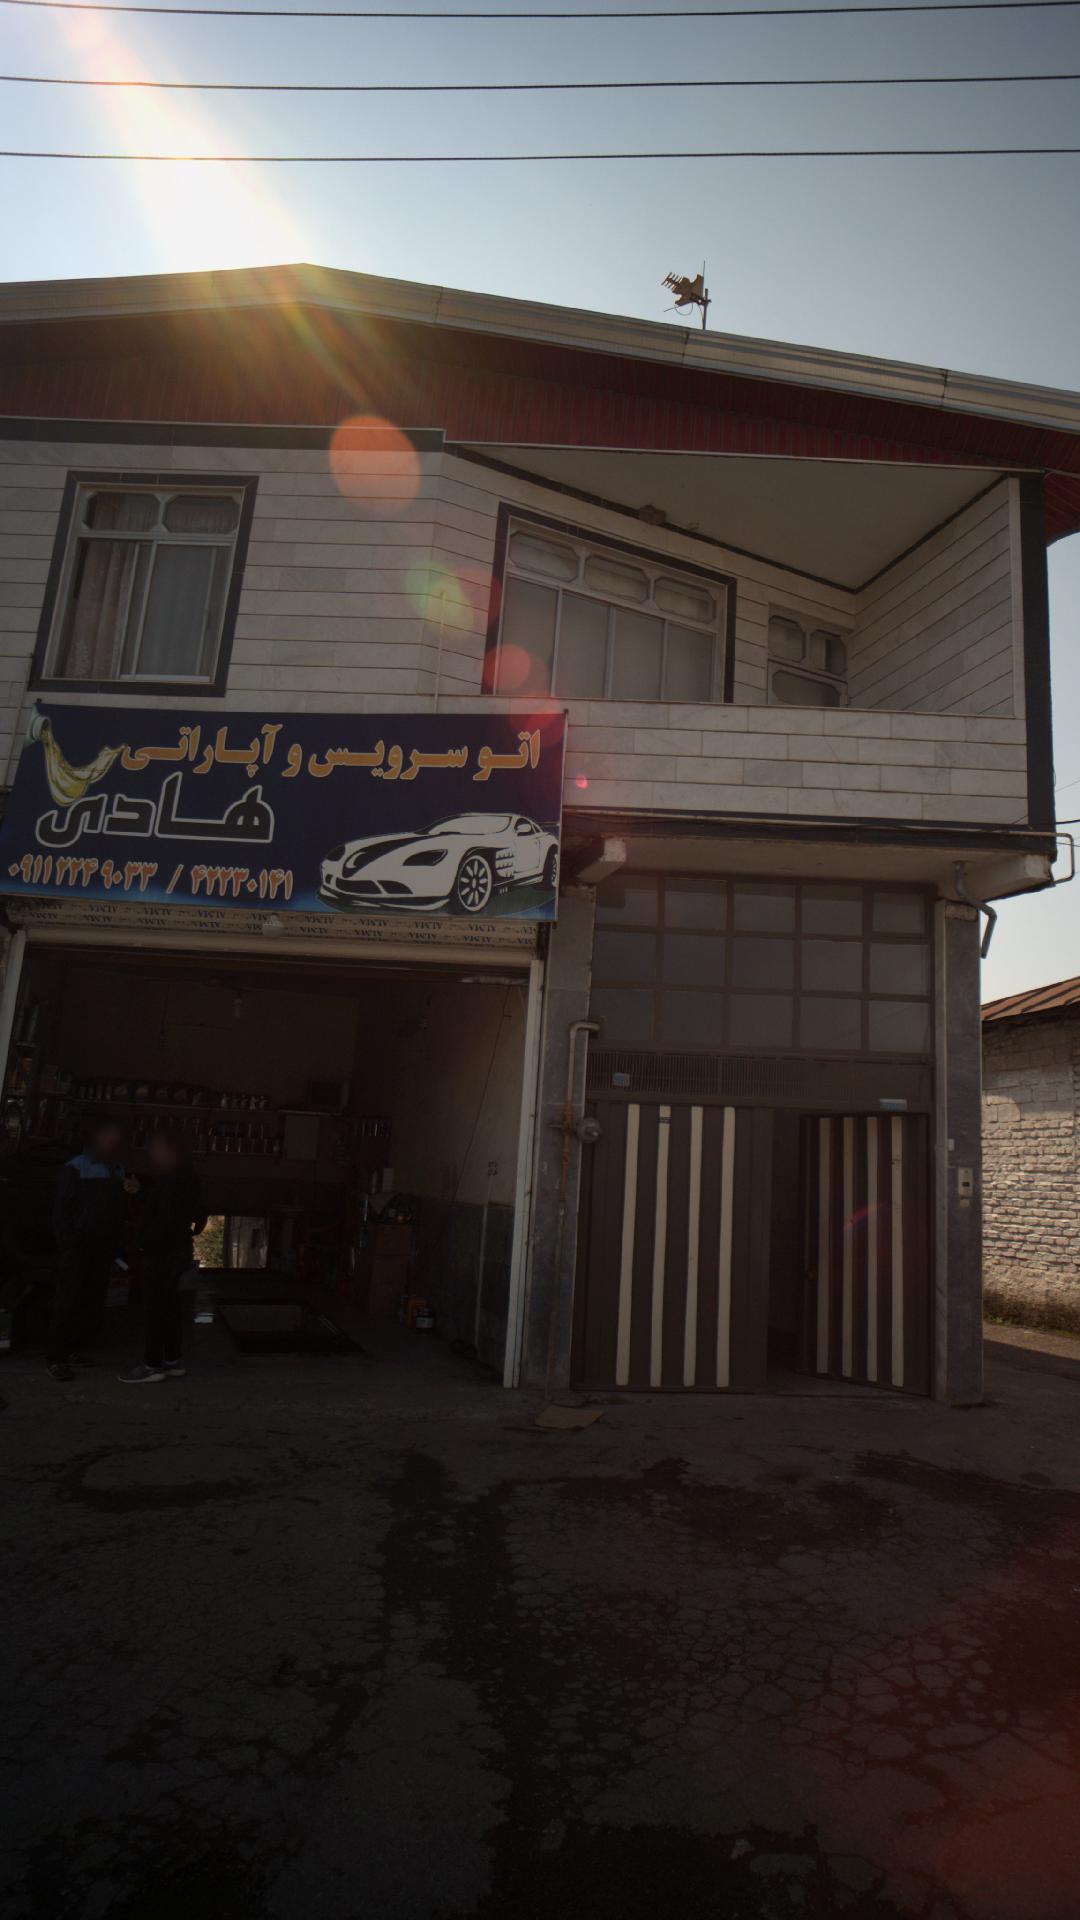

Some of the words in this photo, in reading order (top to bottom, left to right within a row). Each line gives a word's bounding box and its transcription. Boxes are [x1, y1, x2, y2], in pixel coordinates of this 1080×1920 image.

[121, 723, 283, 778] آپاراتی
[281, 743, 302, 777] و
[308, 739, 468, 780] سرویس
[472, 729, 541, 781] اتو
[35, 771, 275, 848] هادی
[190, 864, 294, 900] ۴۲۲۳۰۱۴۱
